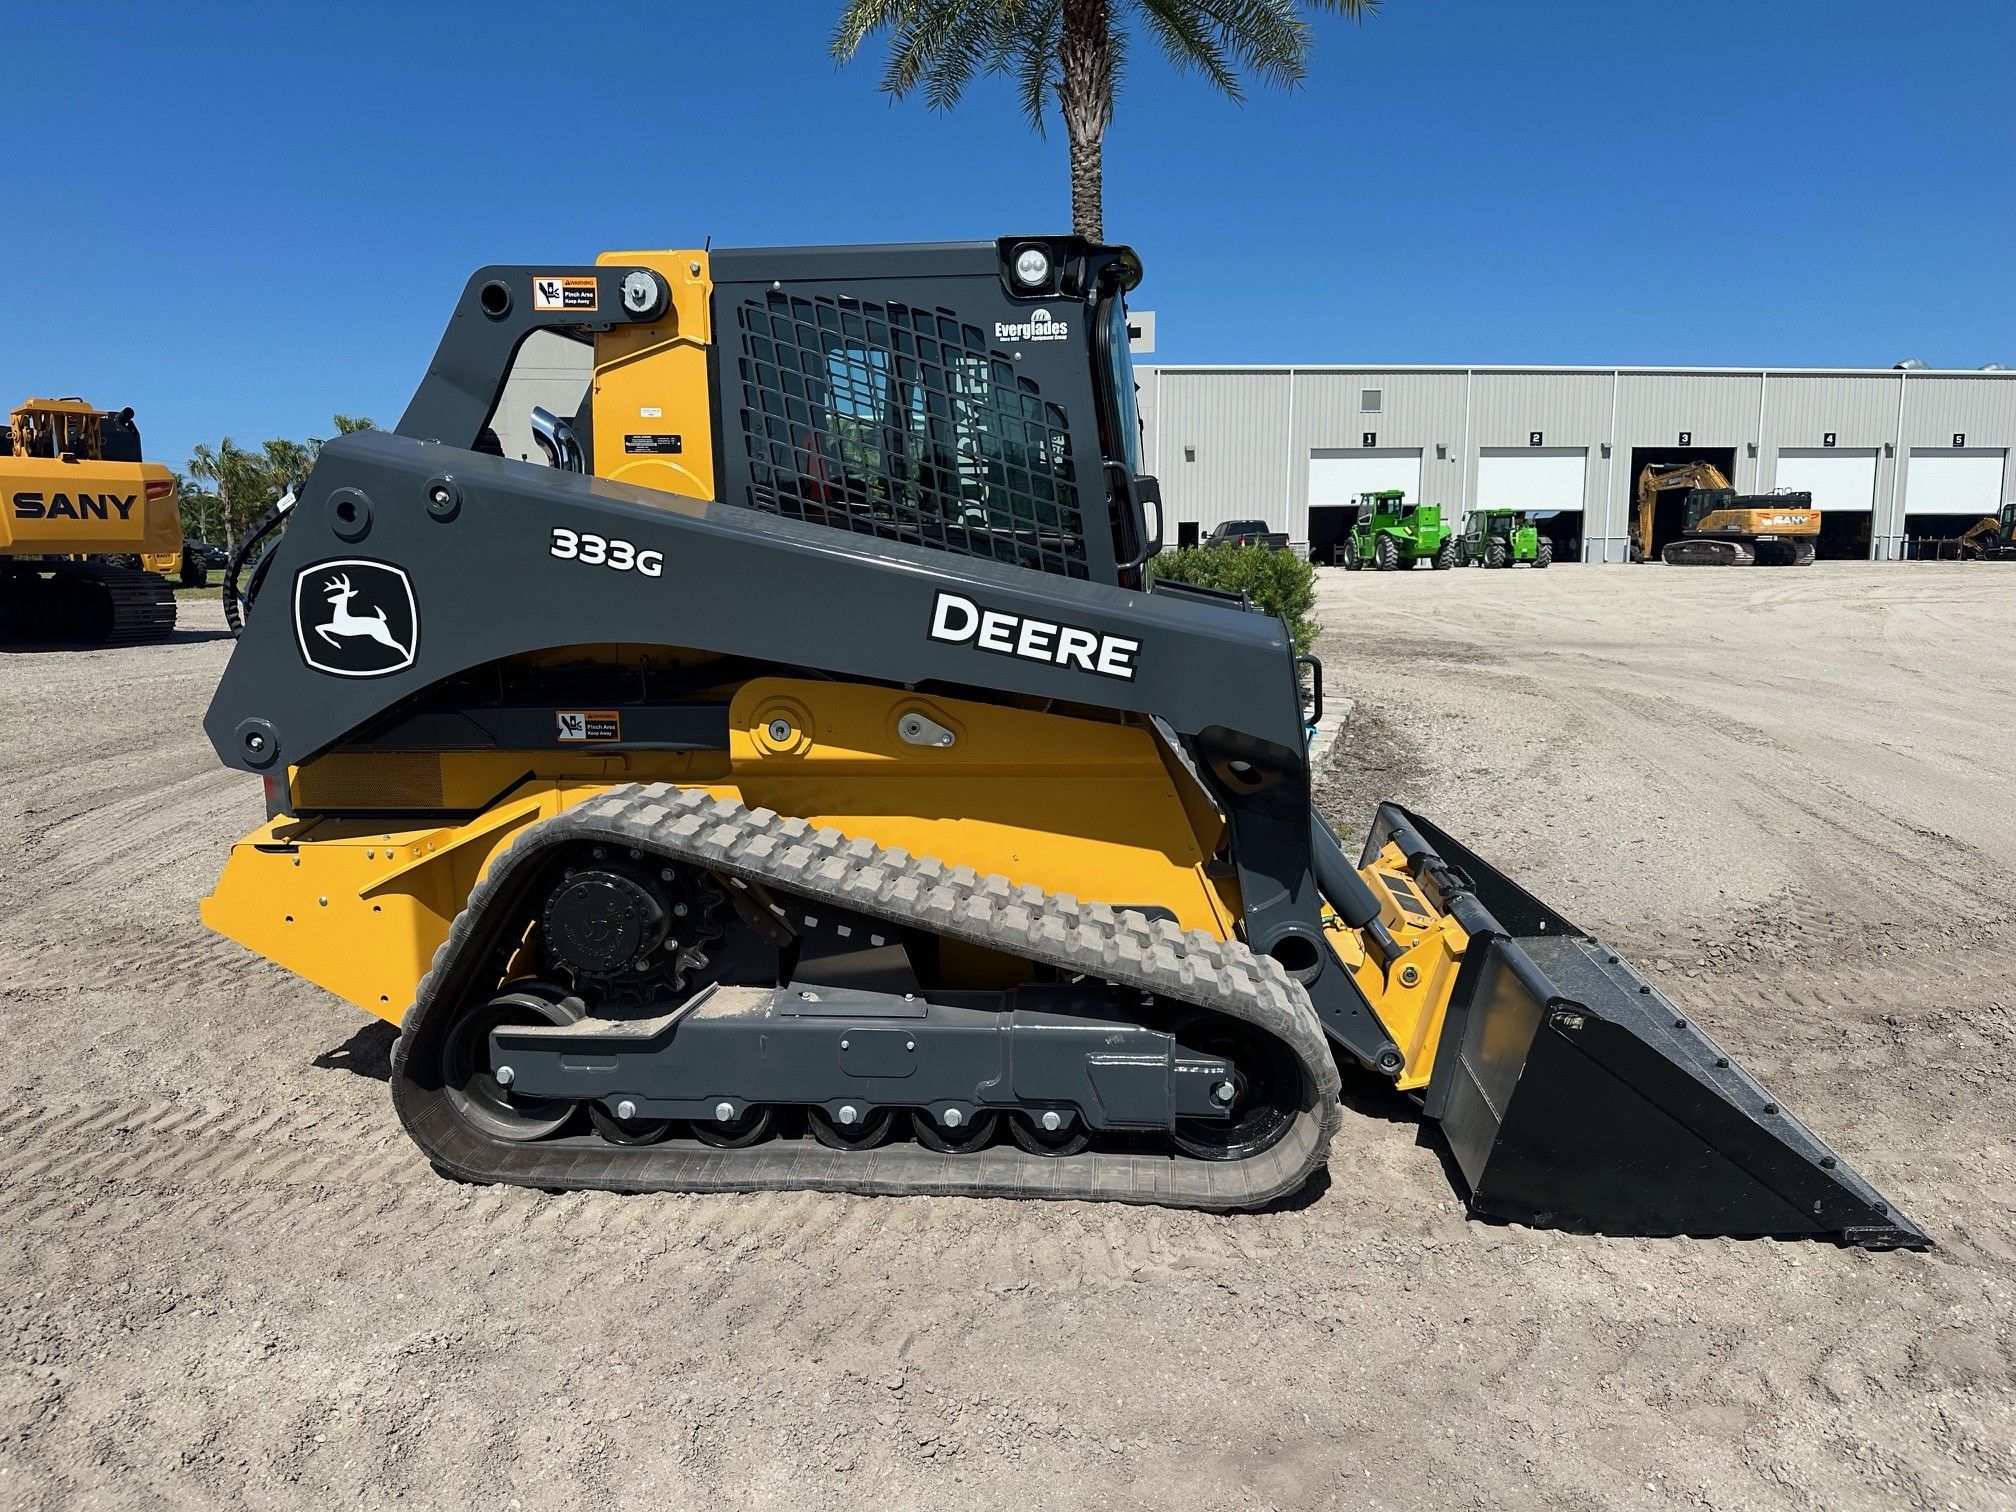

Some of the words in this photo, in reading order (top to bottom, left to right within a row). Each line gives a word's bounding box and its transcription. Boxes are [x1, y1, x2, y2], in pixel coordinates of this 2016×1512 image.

[995, 319, 1068, 340] Everglades
[1366, 434, 1372, 443] 1
[1532, 433, 1540, 443] 2
[1681, 433, 1689, 443] 3
[1826, 434, 1834, 443] 4
[1955, 435, 1963, 444] 5
[13, 492, 138, 520] SANY
[1773, 515, 1808, 526] SANY
[550, 528, 663, 577] 333G
[931, 592, 1139, 679] DEERE
